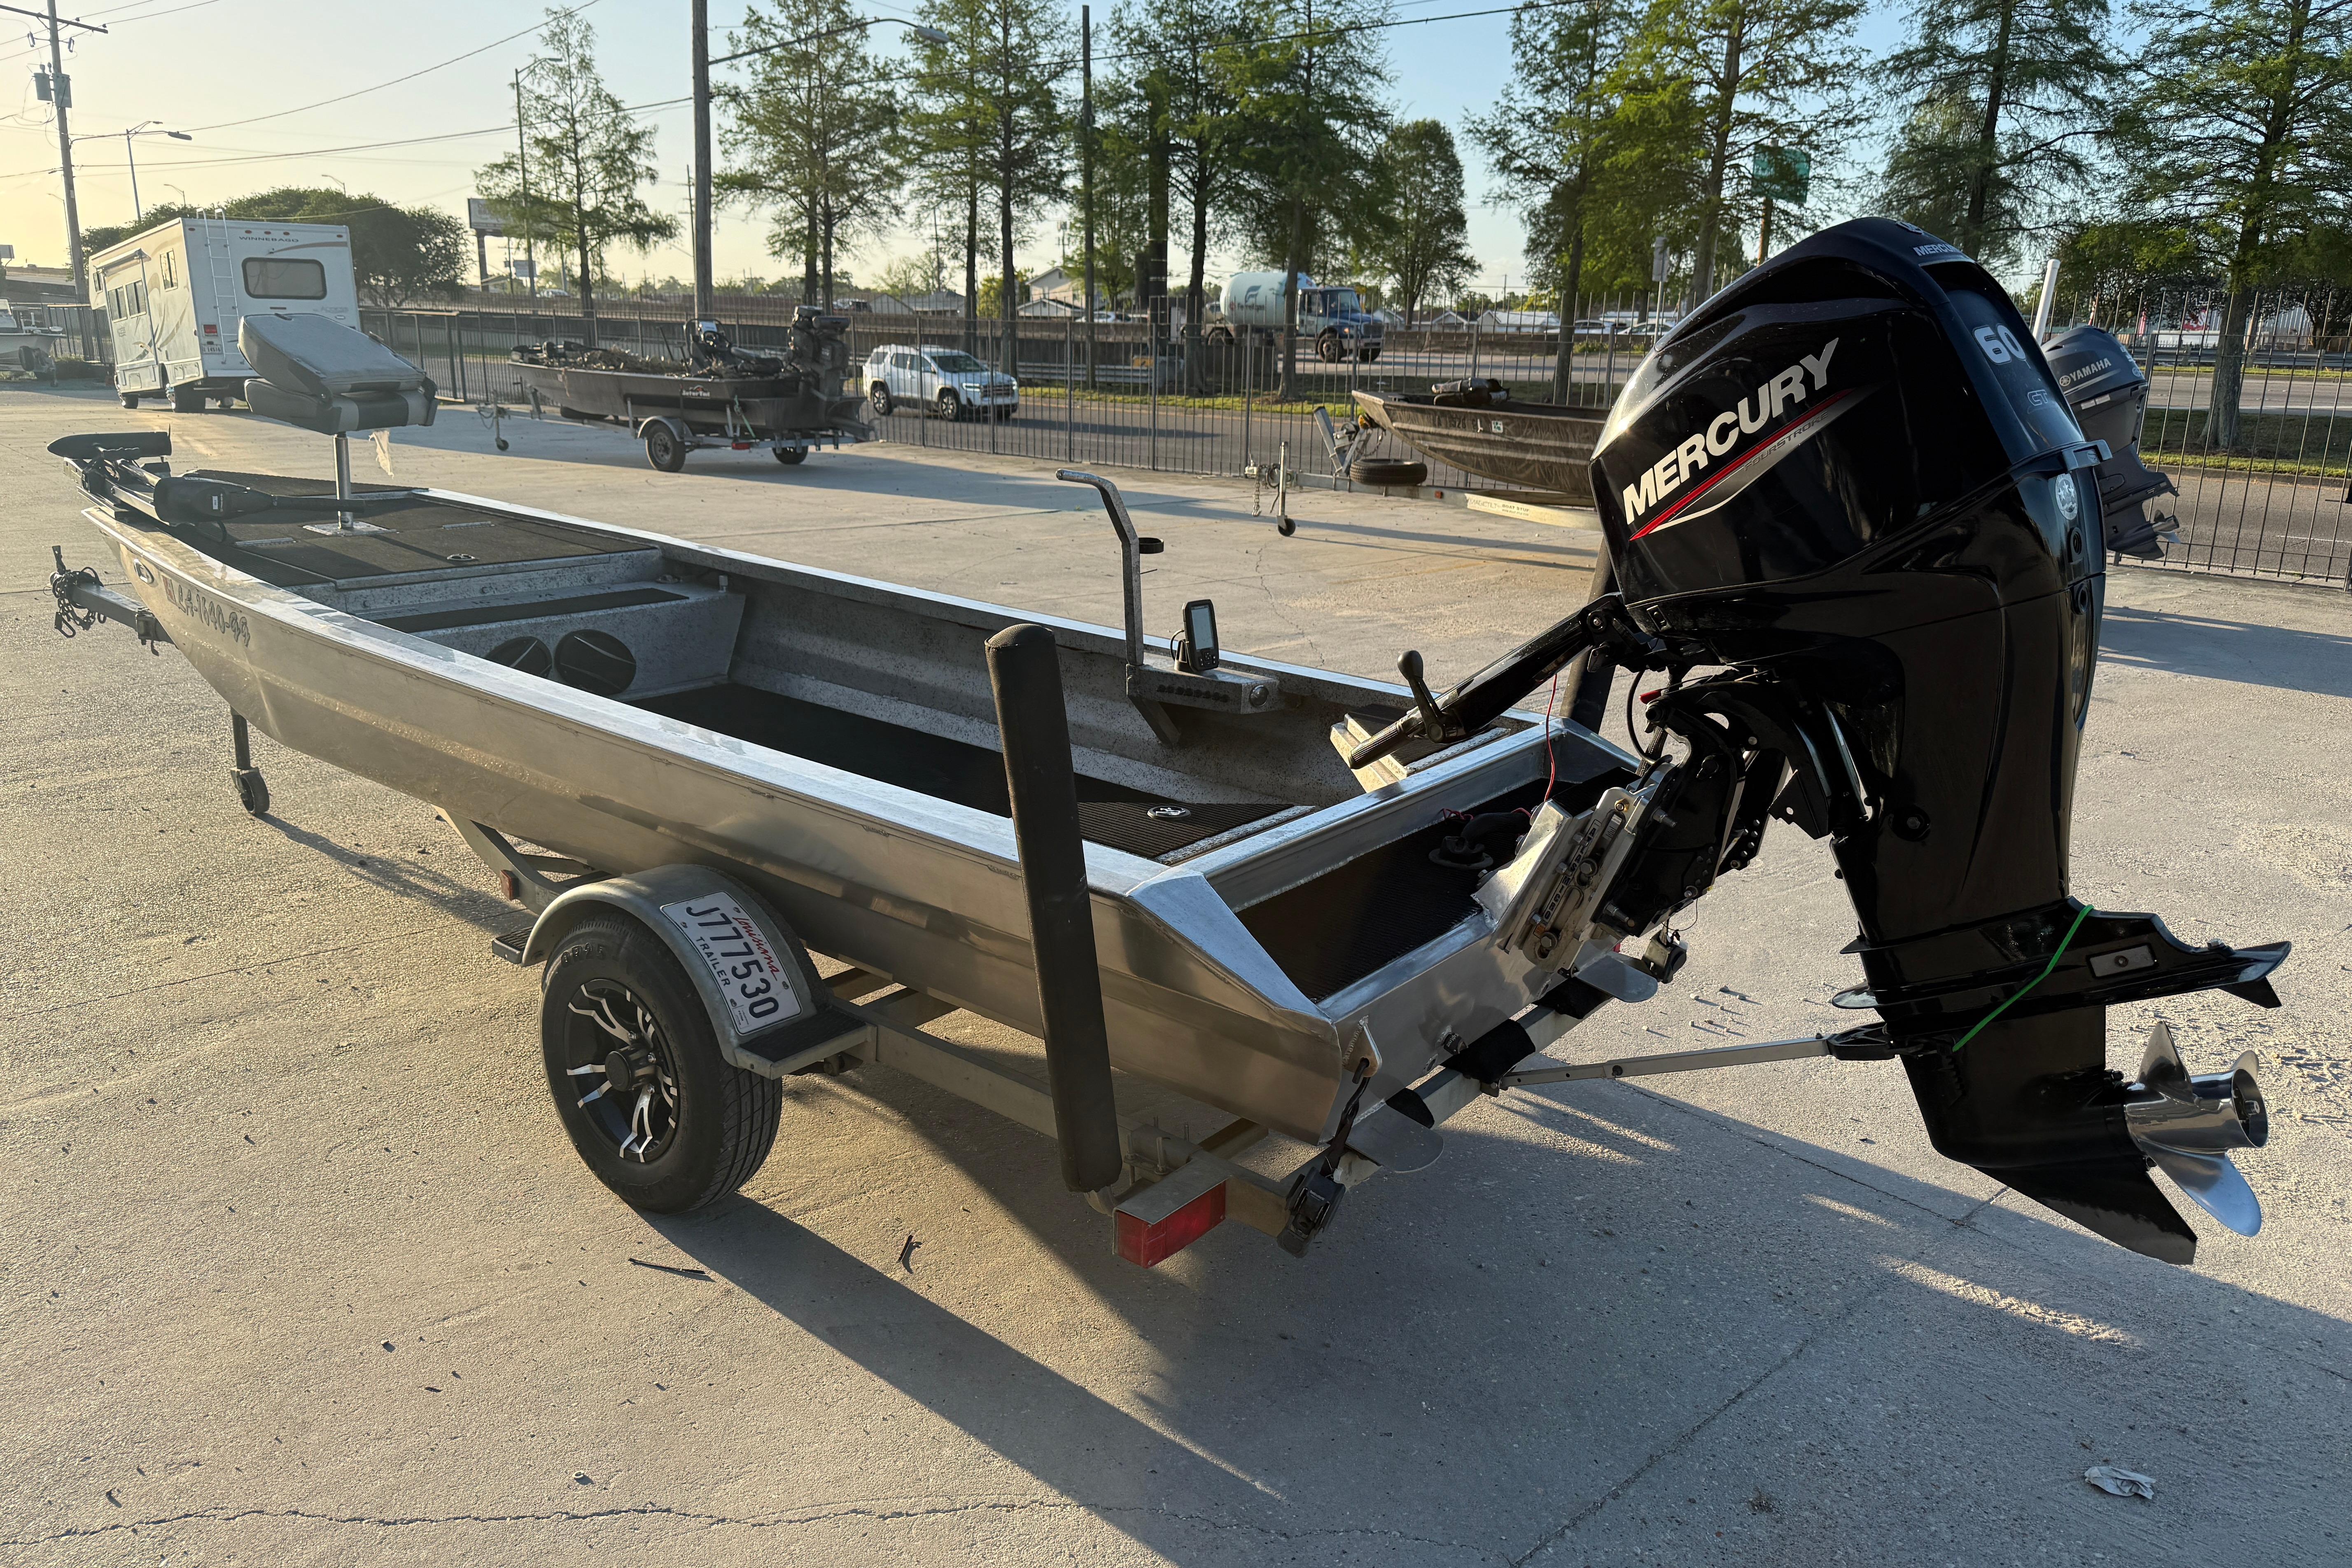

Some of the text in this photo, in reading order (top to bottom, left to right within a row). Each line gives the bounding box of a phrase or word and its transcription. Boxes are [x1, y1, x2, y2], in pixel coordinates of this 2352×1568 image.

[1973, 322, 2027, 365] 60
[2070, 357, 2112, 382] YAMAHA
[1623, 338, 1839, 525] MERCURY
[1743, 410, 1828, 471] FOURSTROKE
[686, 907, 779, 1018] J777530
[696, 936, 731, 986] TRAILER
[732, 917, 780, 981] Louisiana
